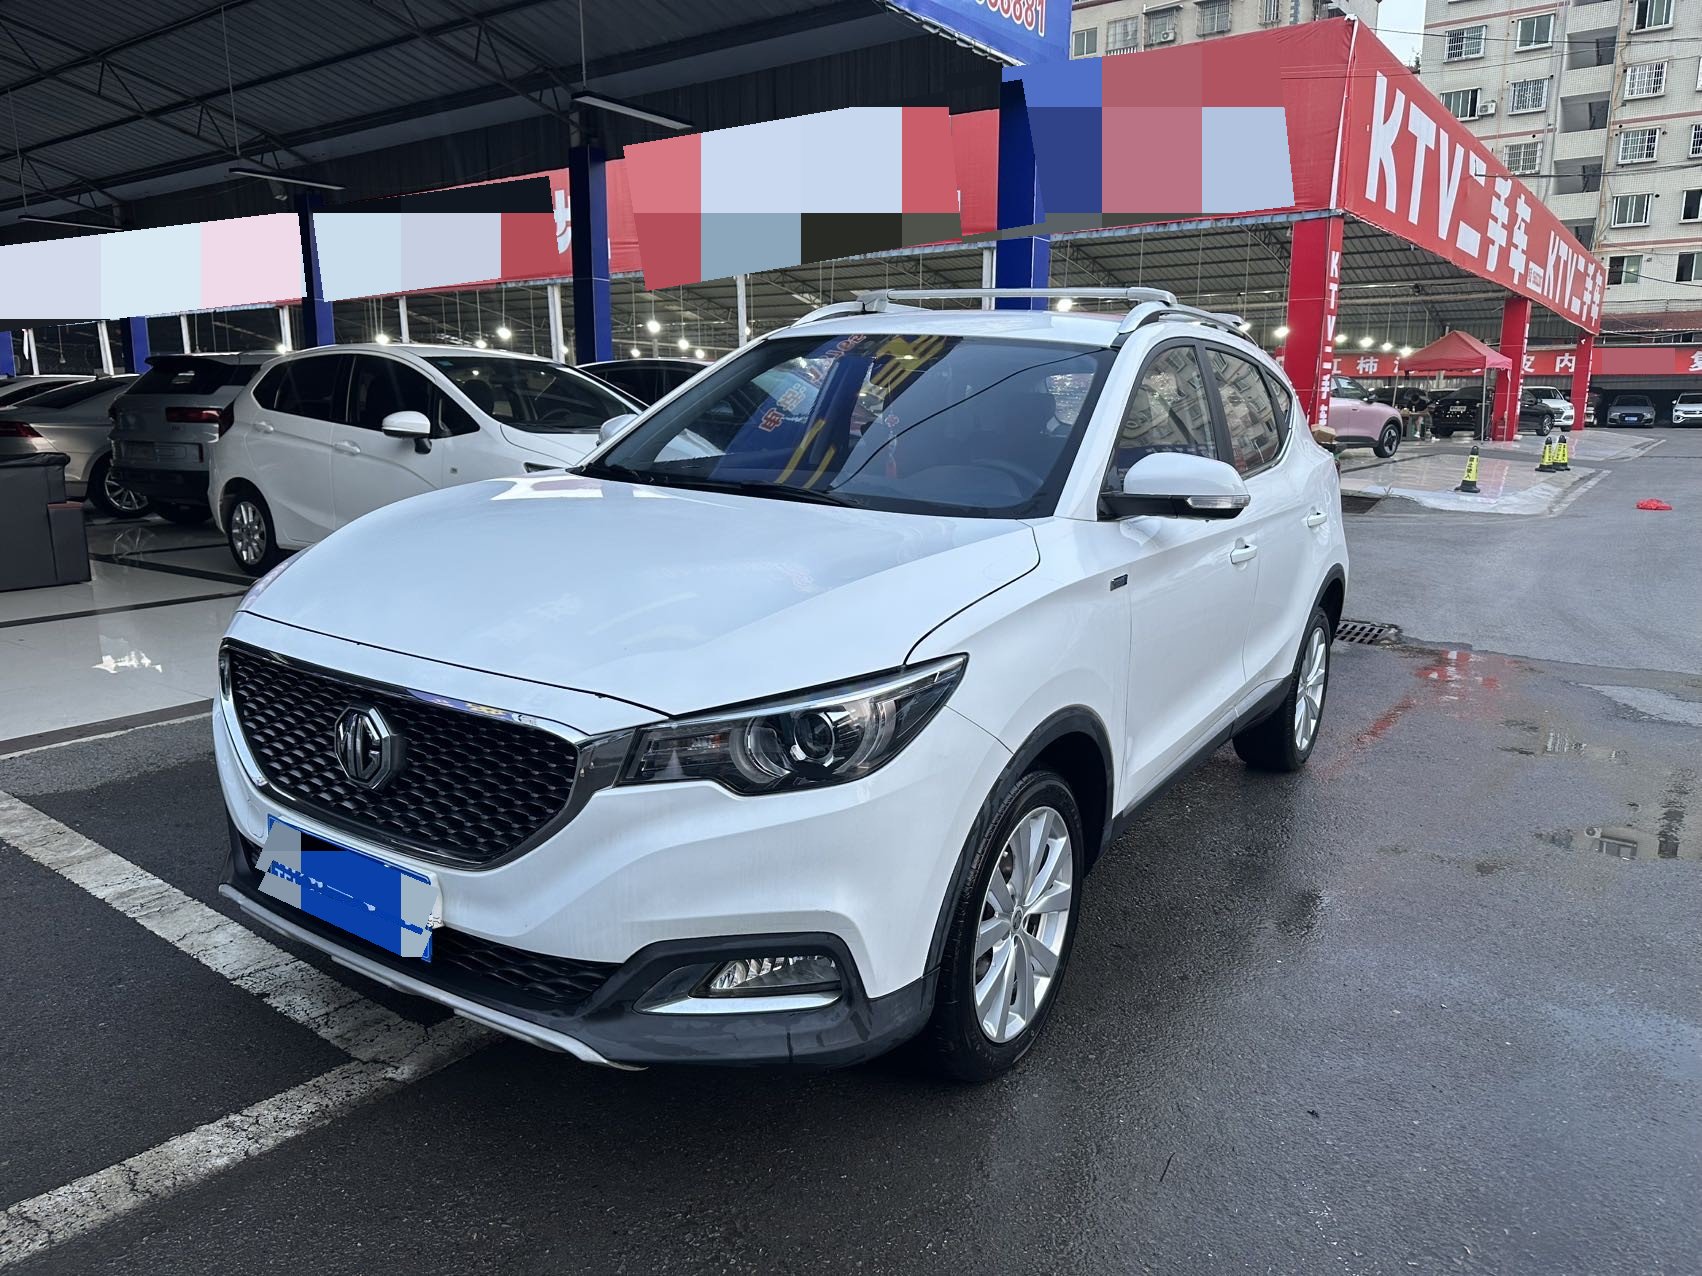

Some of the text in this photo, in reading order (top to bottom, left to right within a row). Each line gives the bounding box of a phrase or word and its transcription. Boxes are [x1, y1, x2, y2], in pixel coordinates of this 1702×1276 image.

[1365, 71, 1532, 285] KTV二手车
[338, 713, 381, 780] MG
